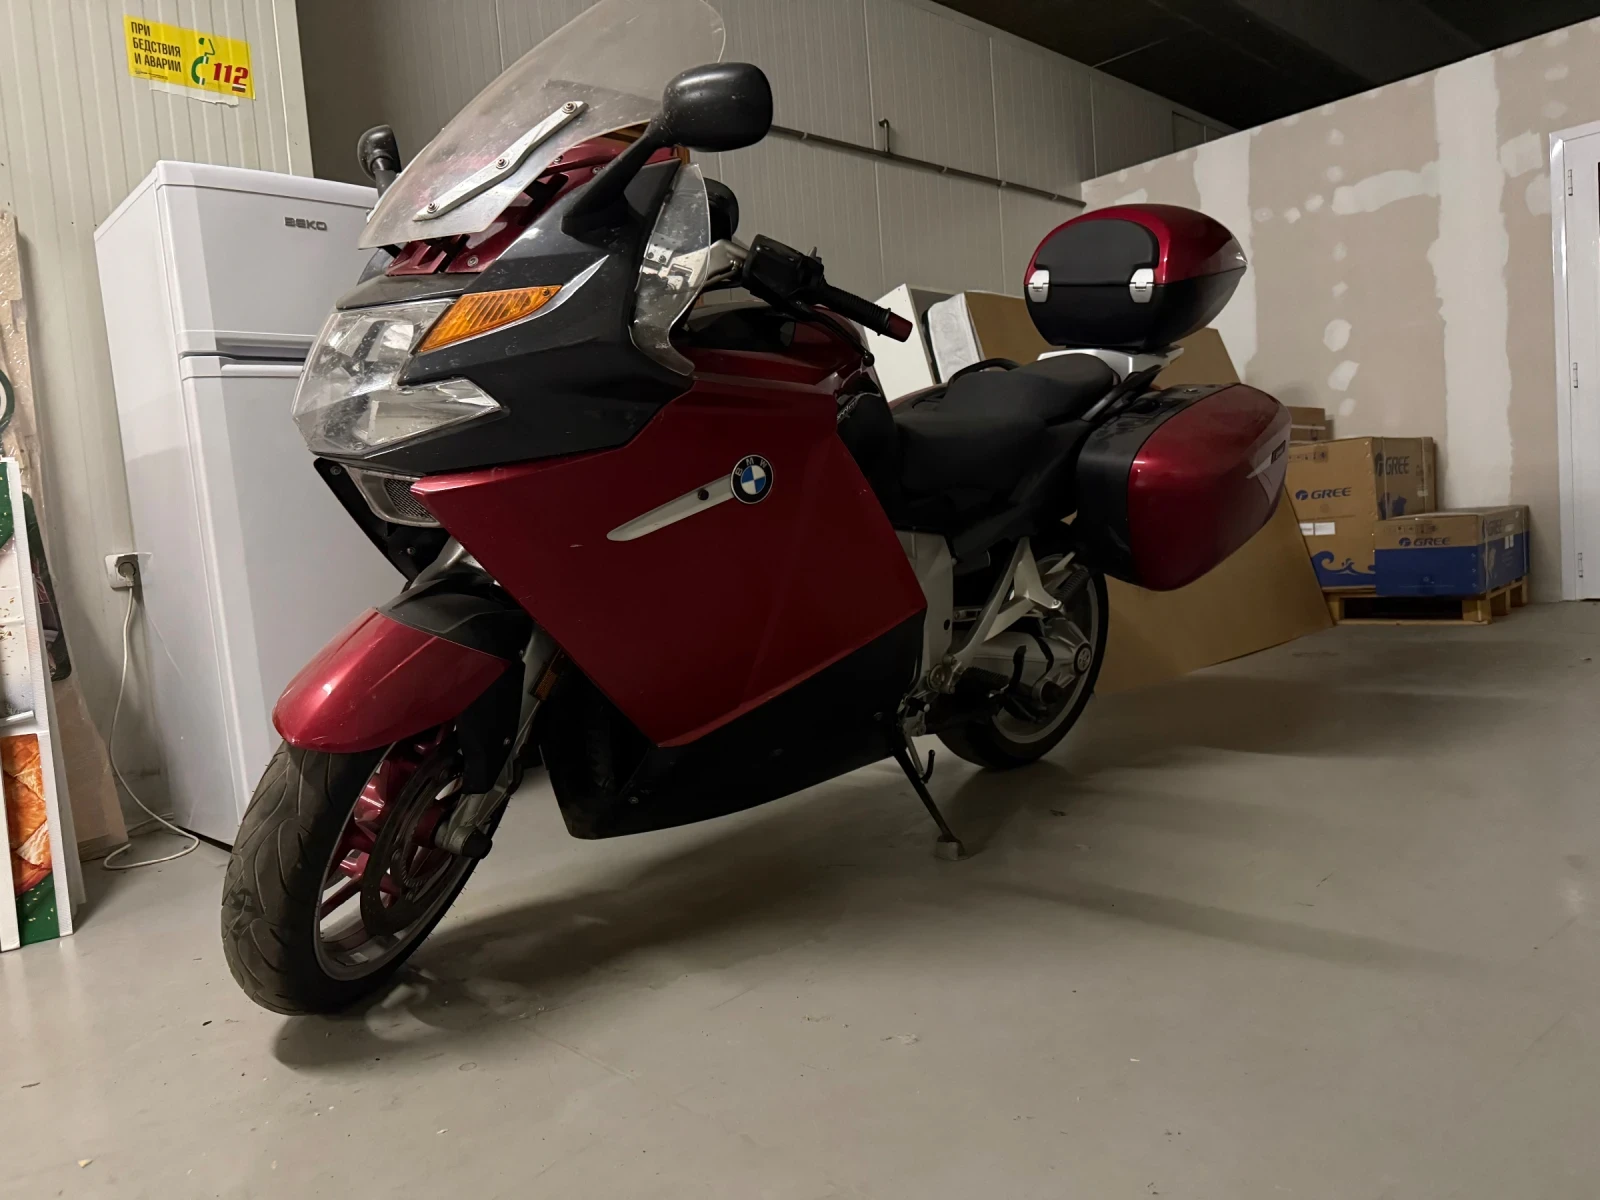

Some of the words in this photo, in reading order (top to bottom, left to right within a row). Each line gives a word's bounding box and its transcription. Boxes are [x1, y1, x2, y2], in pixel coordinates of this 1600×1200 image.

[131, 21, 150, 37] ПРИ
[133, 37, 181, 58] БЕДСТВИЯ
[134, 52, 142, 65] И
[144, 54, 182, 73] АВАРИИ
[213, 62, 249, 87] 112
[284, 216, 328, 231] BEKO
[735, 457, 768, 477] BMW
[1386, 455, 1410, 476] GREE
[1311, 487, 1352, 500] GREE
[1413, 537, 1452, 547] GREE
